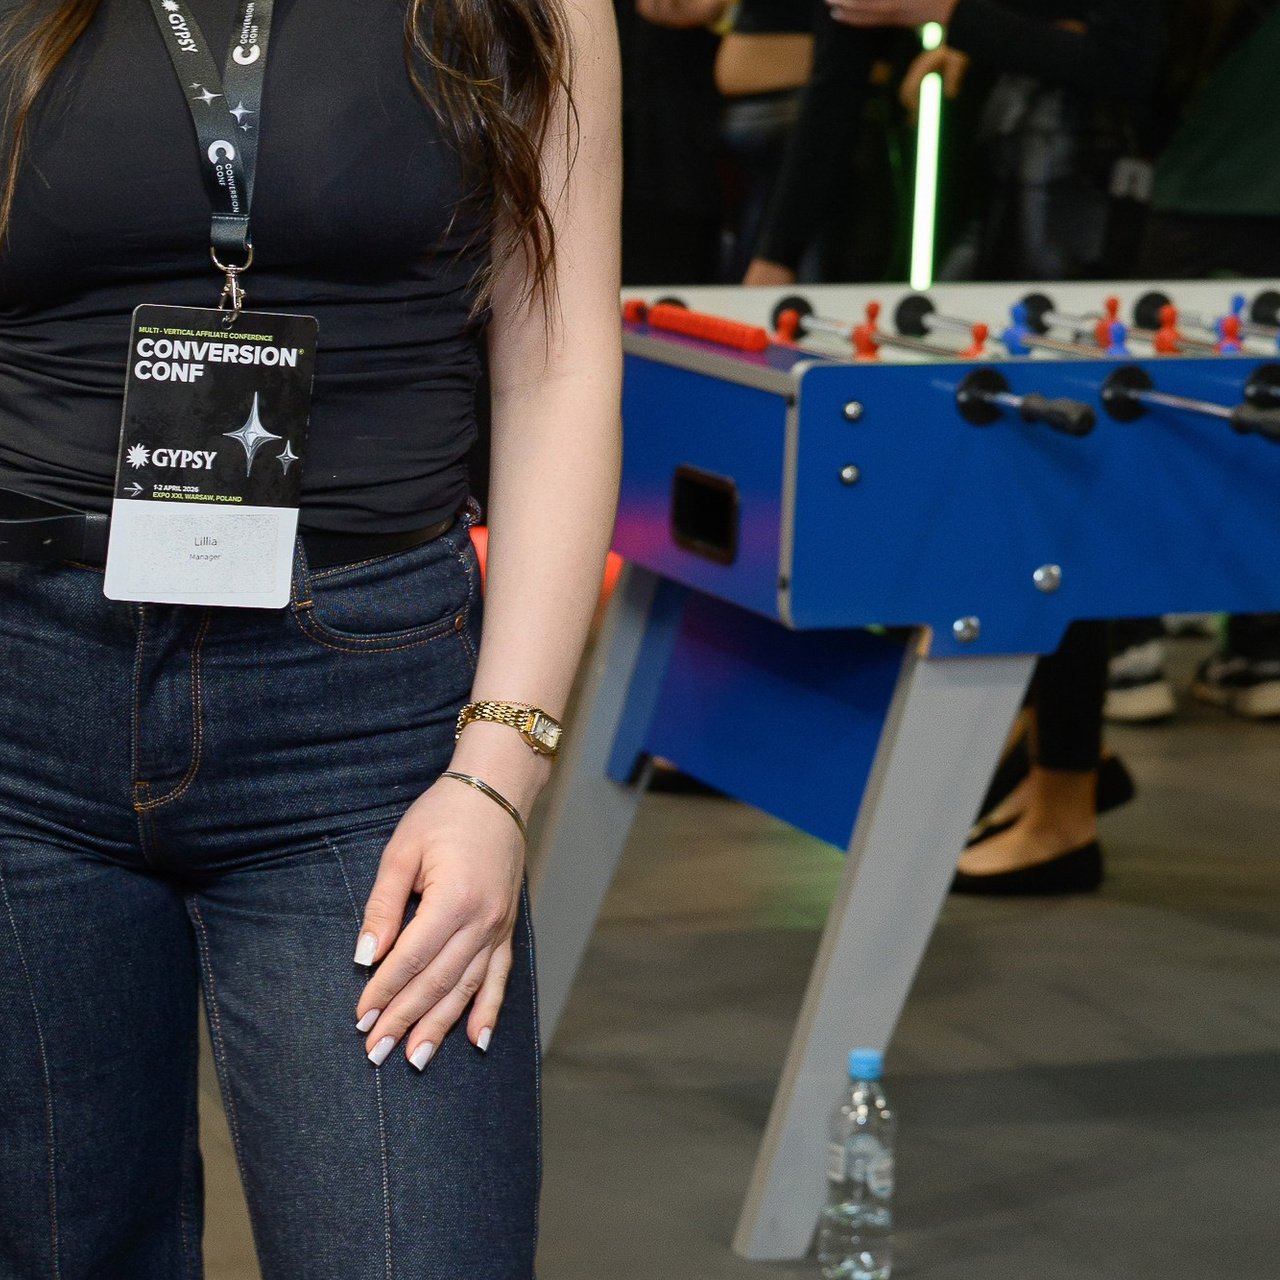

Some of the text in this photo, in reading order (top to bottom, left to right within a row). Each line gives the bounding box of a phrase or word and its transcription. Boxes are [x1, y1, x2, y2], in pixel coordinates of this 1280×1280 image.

[168, 13, 199, 55] GYPSY
[239, 2, 255, 45] CONVERSION
[215, 164, 226, 186] CONF
[225, 163, 240, 213] CONVERSION
[139, 326, 160, 334] MULTI
[163, 328, 195, 336] VERTICAL
[195, 330, 229, 339] AFFILIATE
[229, 332, 274, 342] CONFERENCE
[136, 338, 298, 367] CONVERSION
[134, 360, 204, 383] CONF
[151, 448, 218, 470] GYPSY
[184, 493, 216, 501] WARSAW,
[189, 553, 221, 562] Manager
